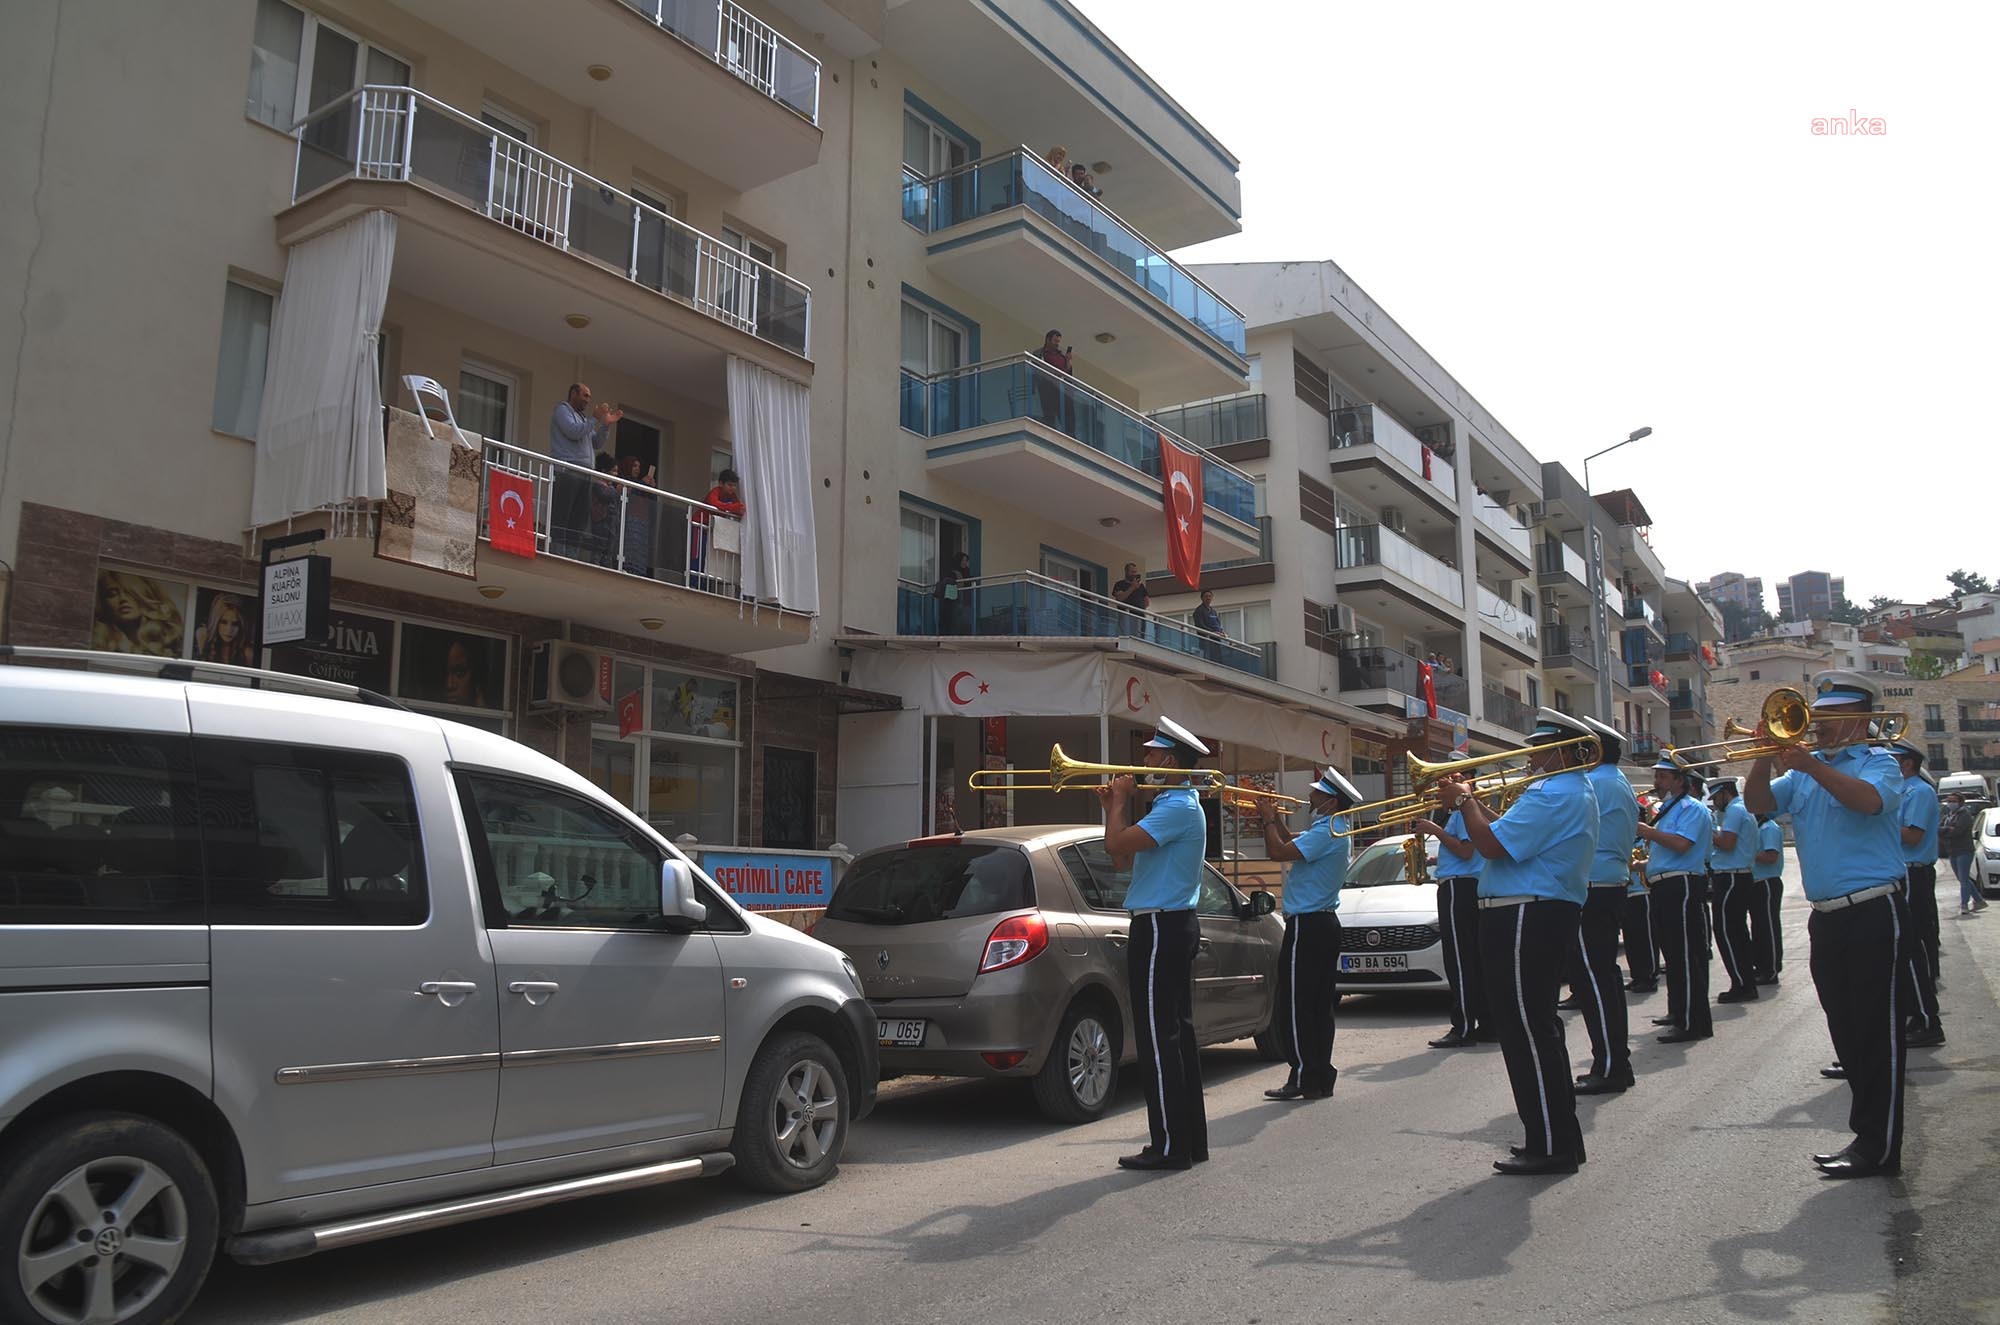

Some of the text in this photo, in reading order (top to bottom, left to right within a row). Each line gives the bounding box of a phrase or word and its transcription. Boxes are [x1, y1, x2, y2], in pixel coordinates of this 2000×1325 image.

[273, 566, 300, 579] ALPİNA
[271, 577, 302, 593] KUAFÖR
[271, 592, 301, 605] SALONU
[715, 863, 824, 895] SEVİMLİ CAFE
[1347, 956, 1404, 969] 09 BA 694
[896, 1021, 921, 1039] 065
